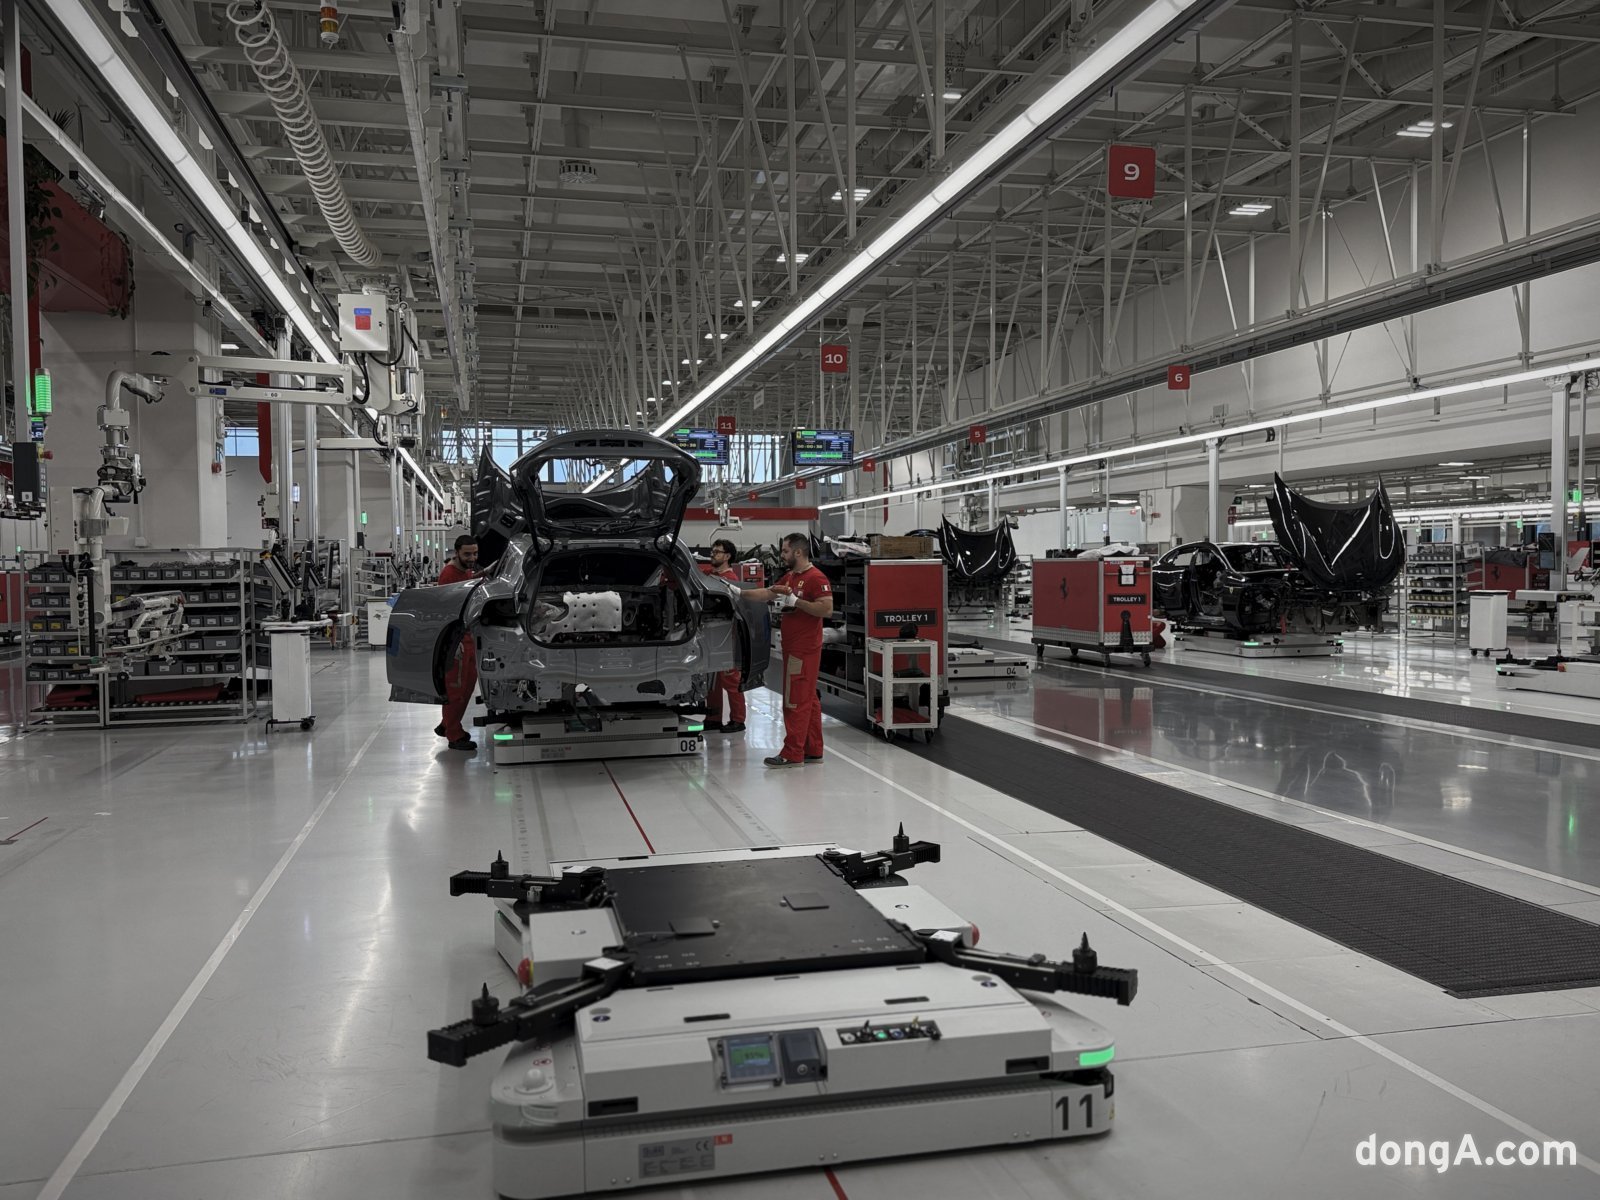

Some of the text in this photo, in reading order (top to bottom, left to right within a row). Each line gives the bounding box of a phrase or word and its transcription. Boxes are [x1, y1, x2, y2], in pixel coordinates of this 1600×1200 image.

[1124, 163, 1140, 181] 9
[825, 354, 843, 364] 10
[1175, 373, 1183, 382] 6
[721, 422, 732, 430] 11
[884, 614, 928, 623] TROLLEY 1
[1006, 667, 1016, 675] 04
[680, 740, 697, 752] 08
[1056, 1093, 1093, 1131] 11
